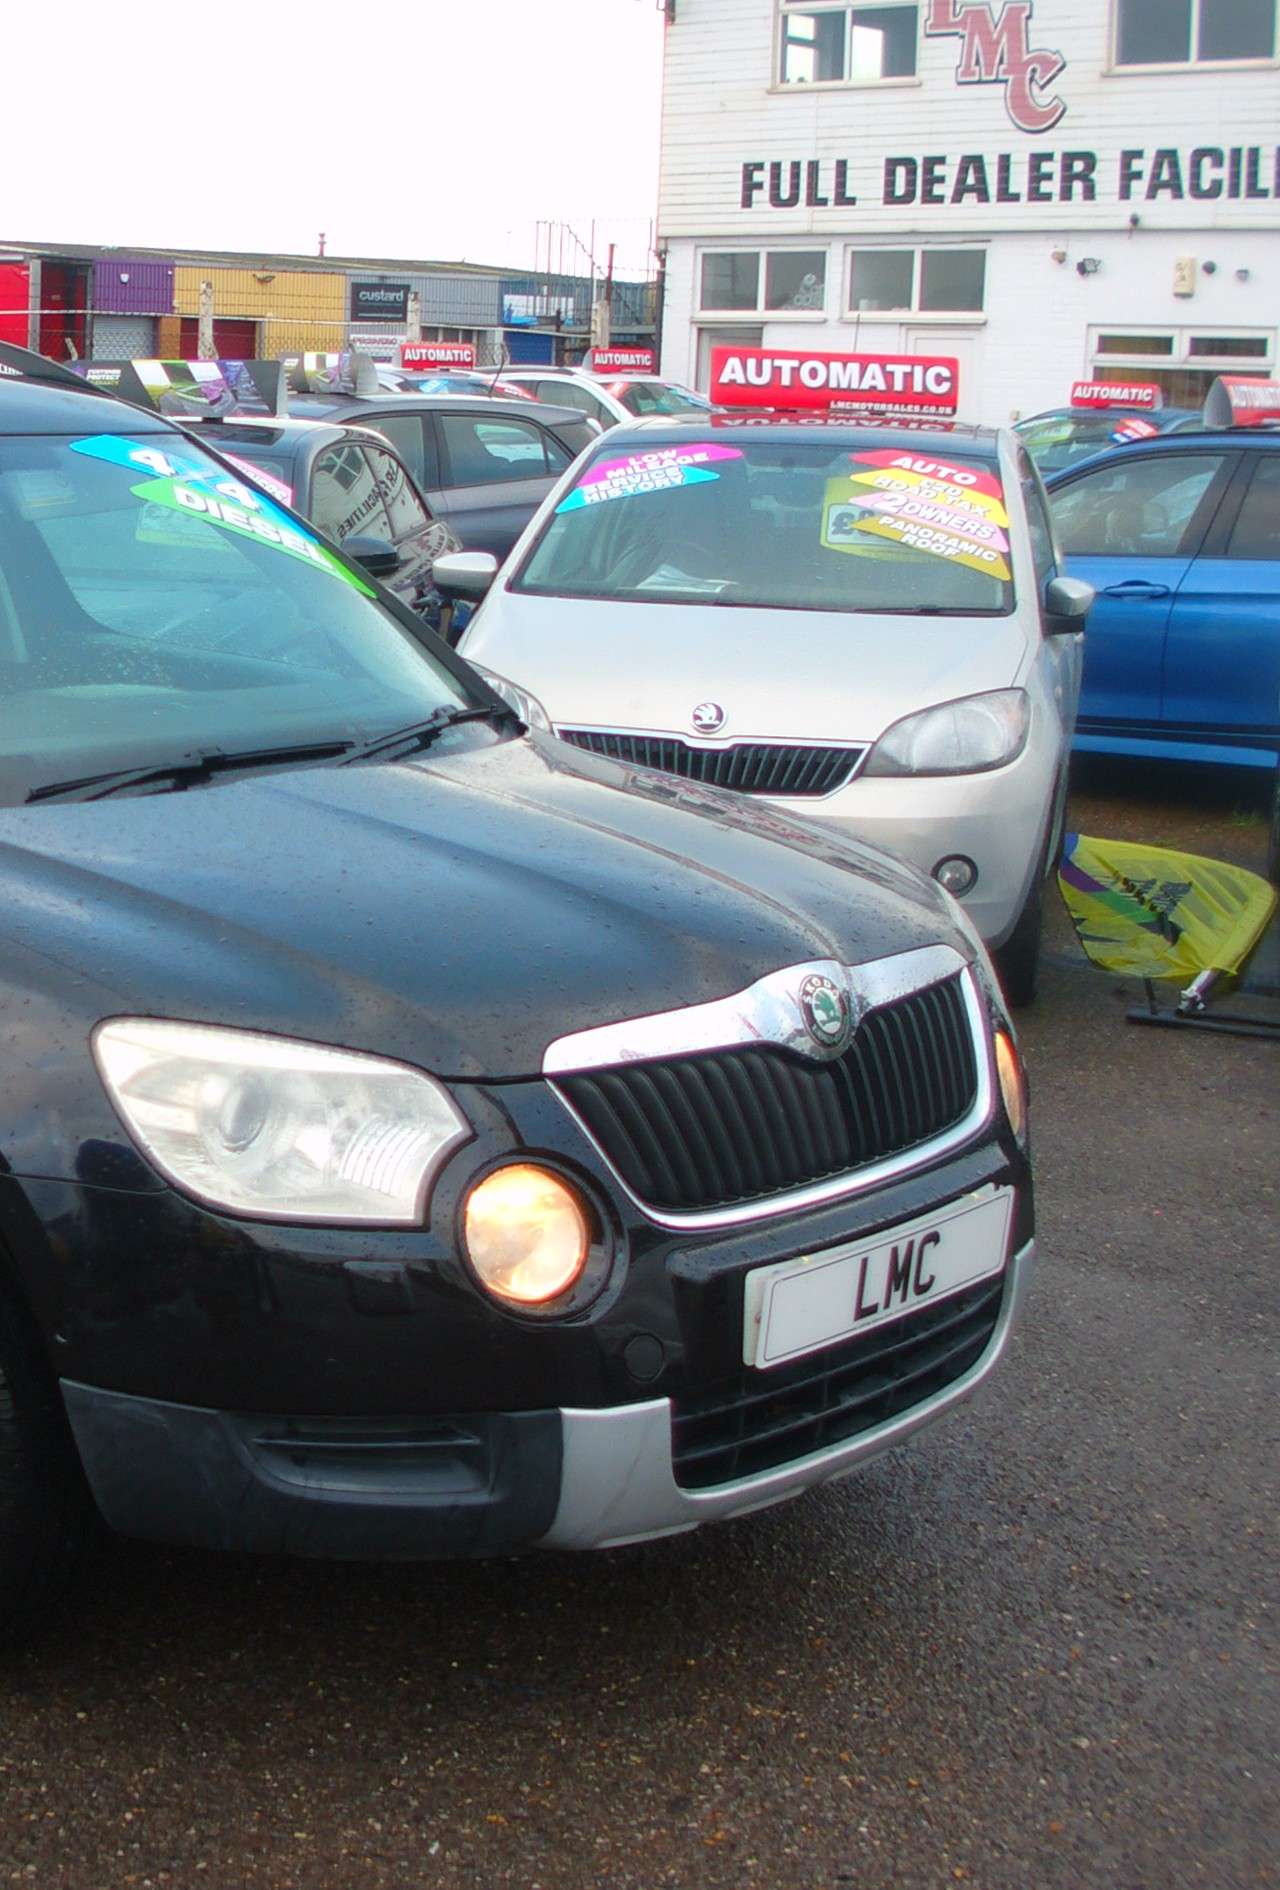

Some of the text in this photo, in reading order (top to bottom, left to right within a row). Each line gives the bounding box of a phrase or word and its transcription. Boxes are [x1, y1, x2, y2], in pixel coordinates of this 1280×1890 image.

[740, 146, 1280, 209] FULL DEALER FACIL
[359, 289, 404, 302] custard
[404, 348, 472, 363] AUTOMATIC
[594, 352, 653, 366] AUTOMATIC
[718, 357, 952, 395] AUTOMATIC
[1072, 385, 1153, 402] AUTOMATIC
[605, 451, 710, 480] MILEAGE
[627, 449, 678, 467] LOW
[890, 456, 978, 486] AUTO
[583, 464, 682, 495] SERVICE
[583, 473, 685, 505] HISTORY
[873, 476, 991, 518] ROAD TAX
[877, 491, 909, 514] 2
[904, 501, 998, 541] OWNERS
[877, 515, 998, 562] PANORAMIC
[900, 534, 962, 557] ROOF
[853, 1230, 941, 1323] LMC
